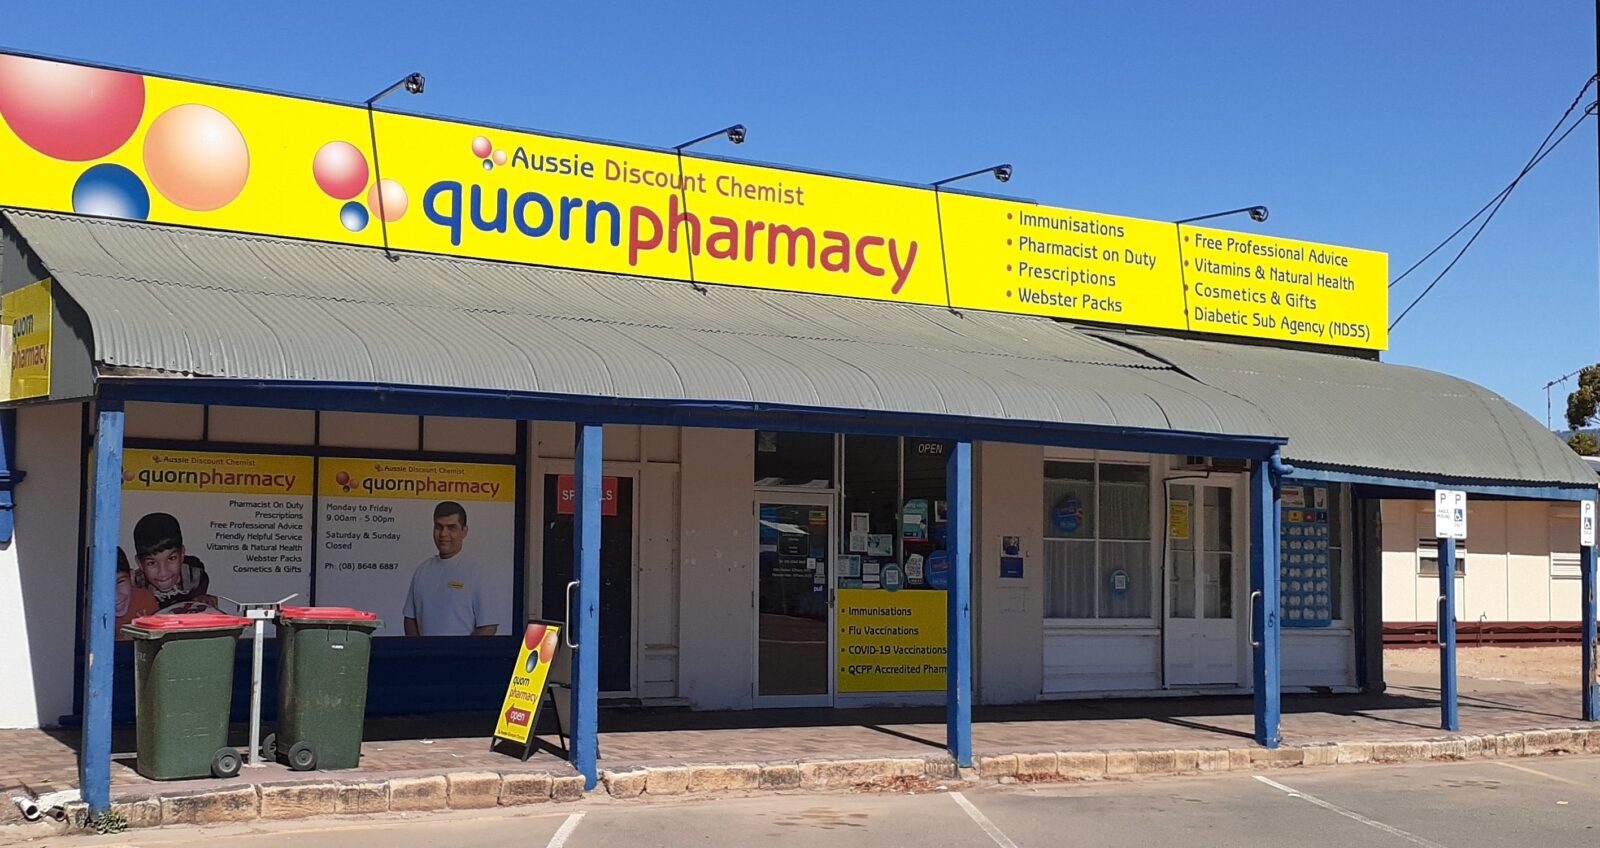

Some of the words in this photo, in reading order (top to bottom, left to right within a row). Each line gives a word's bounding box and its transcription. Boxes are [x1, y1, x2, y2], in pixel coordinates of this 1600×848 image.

[511, 146, 594, 178] Aussie
[605, 159, 707, 193] Discount
[716, 175, 805, 206] Chemist
[1019, 210, 1125, 238] Immunisations
[1018, 236, 1098, 261] Pharmacist
[1102, 249, 1120, 262] on
[1124, 250, 1157, 271] Duty
[1194, 233, 1223, 251] Free
[1226, 238, 1305, 261] Professional
[1308, 248, 1349, 267] Advice
[1018, 262, 1116, 288] Prescriptions
[1194, 257, 1251, 278] Vitamins
[1255, 265, 1266, 280] &
[1270, 267, 1314, 286] Natural
[1317, 272, 1355, 291] Health
[1018, 288, 1079, 308] Webster
[1082, 293, 1123, 313] Packs
[1194, 282, 1267, 305] Cosmetics
[1270, 291, 1281, 305] &
[1285, 292, 1317, 311] Gifts
[13, 314, 34, 344] quorn
[1194, 307, 1248, 327] Diabetic
[1252, 312, 1277, 329] Sub
[1280, 316, 1325, 339] Agency
[1328, 320, 1371, 342] (NDSS)
[12, 342, 48, 378] pharmacy
[918, 443, 943, 454] OPEN
[163, 456, 189, 464] Aussie
[191, 456, 225, 466] Discount
[226, 458, 256, 467] Chemist
[384, 465, 407, 473] Aussie
[409, 466, 437, 474] Discount
[438, 467, 465, 475] Chemist
[1440, 493, 1447, 504] P
[1455, 494, 1461, 504] P
[229, 500, 271, 508] Pharmacist
[286, 501, 304, 510] Duty
[326, 503, 357, 512] Monday
[369, 504, 393, 513] Friday
[1585, 503, 1591, 514] P
[255, 511, 303, 519] Prescriptions
[229, 521, 275, 529] Professional
[277, 522, 303, 530] Advice
[215, 532, 245, 541] Friendly
[247, 532, 273, 541] Helpful
[275, 533, 303, 541] Service
[325, 531, 361, 540] Saturday
[371, 532, 401, 541] Sunday
[206, 543, 240, 551] Vitamins
[242, 543, 249, 551] &
[325, 541, 352, 550] Closed
[246, 554, 278, 562] Webster
[233, 565, 273, 573] Cosmetics
[339, 562, 355, 571] (08)
[848, 606, 912, 616] Immunisations
[848, 626, 862, 635] Flu
[864, 626, 920, 635] Vaccinations
[848, 645, 891, 655] COVID-19
[893, 645, 947, 655] Vaccinations
[848, 665, 873, 675] QCPP
[874, 665, 921, 674] Accredited
[513, 675, 530, 687] quorn
[508, 687, 539, 705] pharmacy
[510, 709, 526, 722] open
